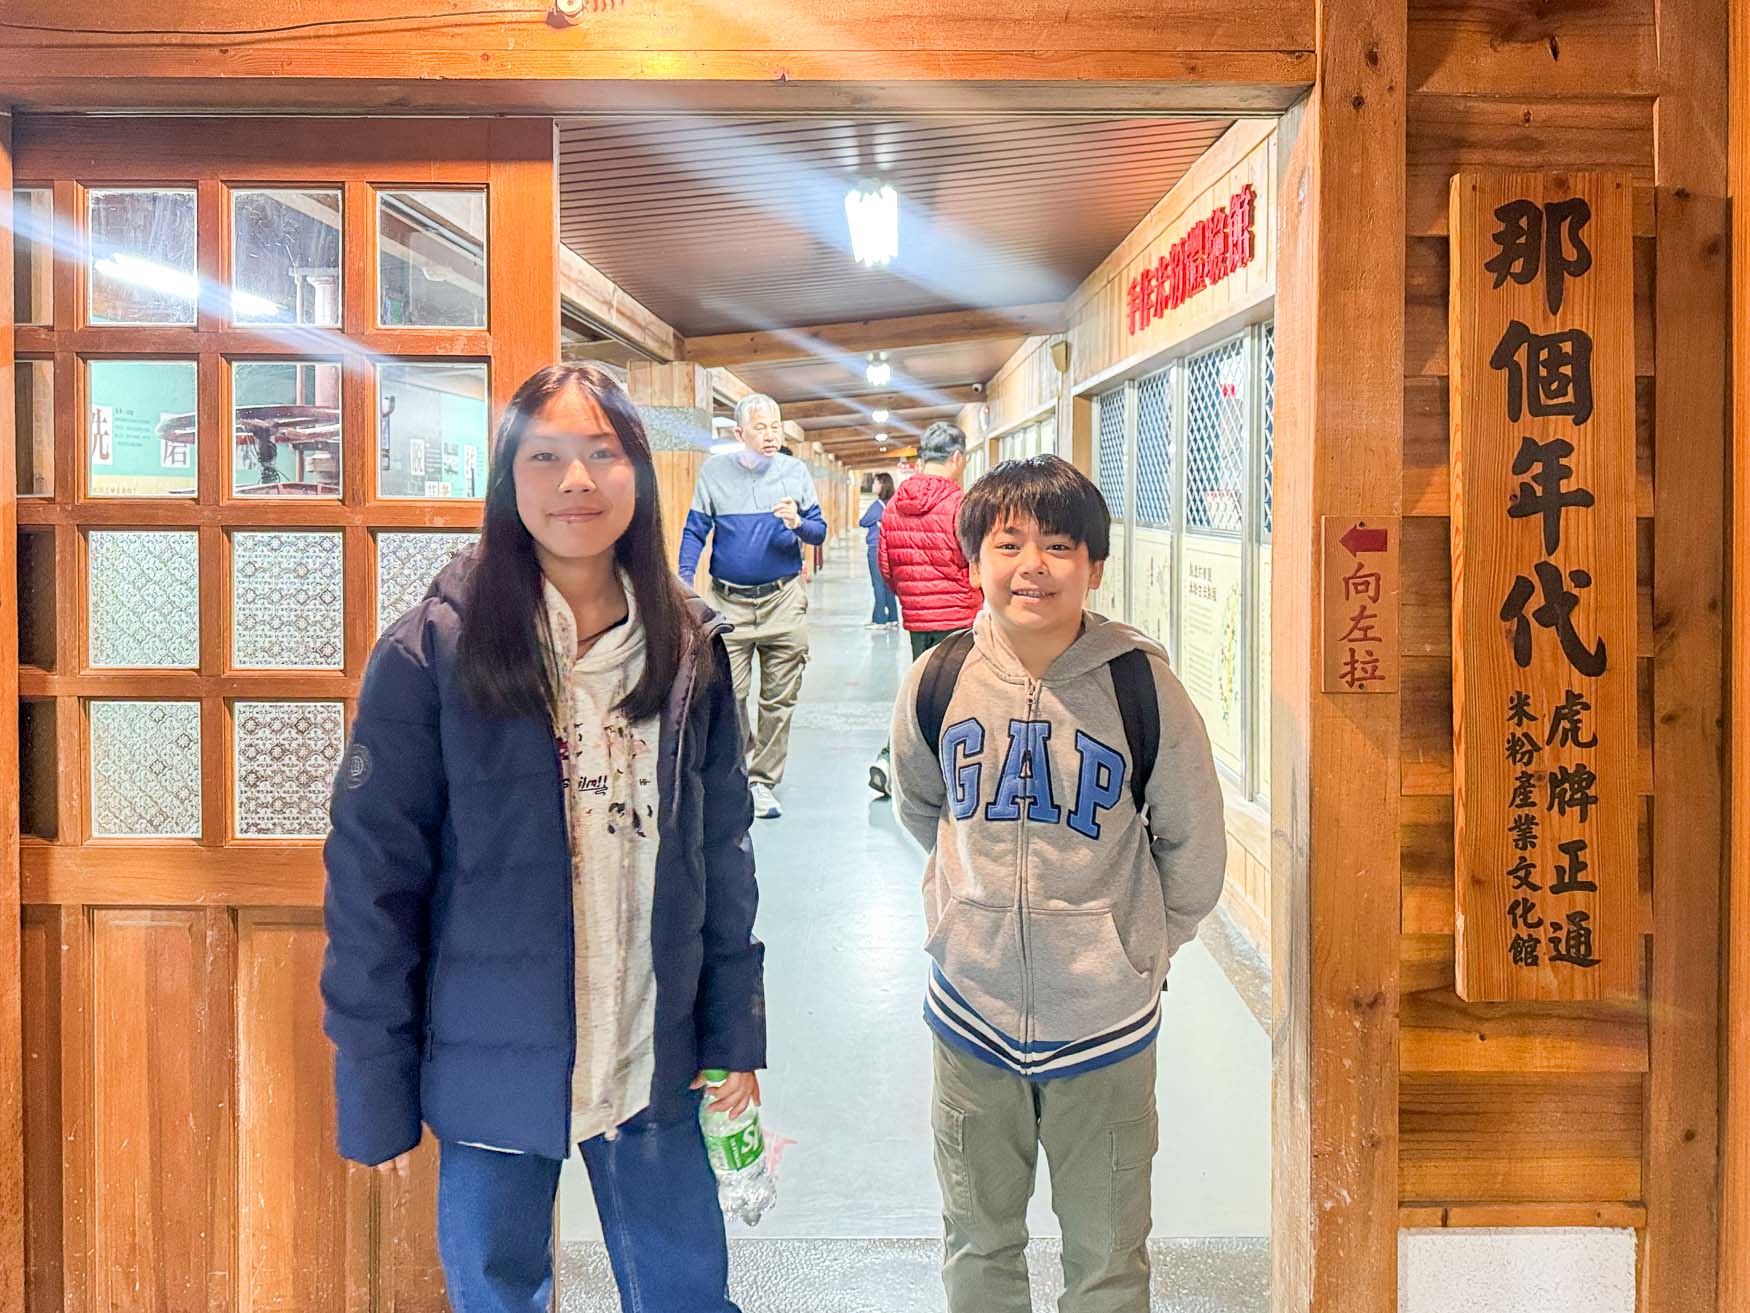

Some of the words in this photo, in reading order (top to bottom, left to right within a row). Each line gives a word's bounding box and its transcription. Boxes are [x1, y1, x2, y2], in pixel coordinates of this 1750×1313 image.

[1484, 197, 1608, 678] 那個年代
[1337, 562, 1386, 688] 向左拉
[941, 717, 1127, 840] GAP
[1505, 690, 1544, 967] 米粉產業文化館
[1546, 689, 1601, 967] 虎牌正通
